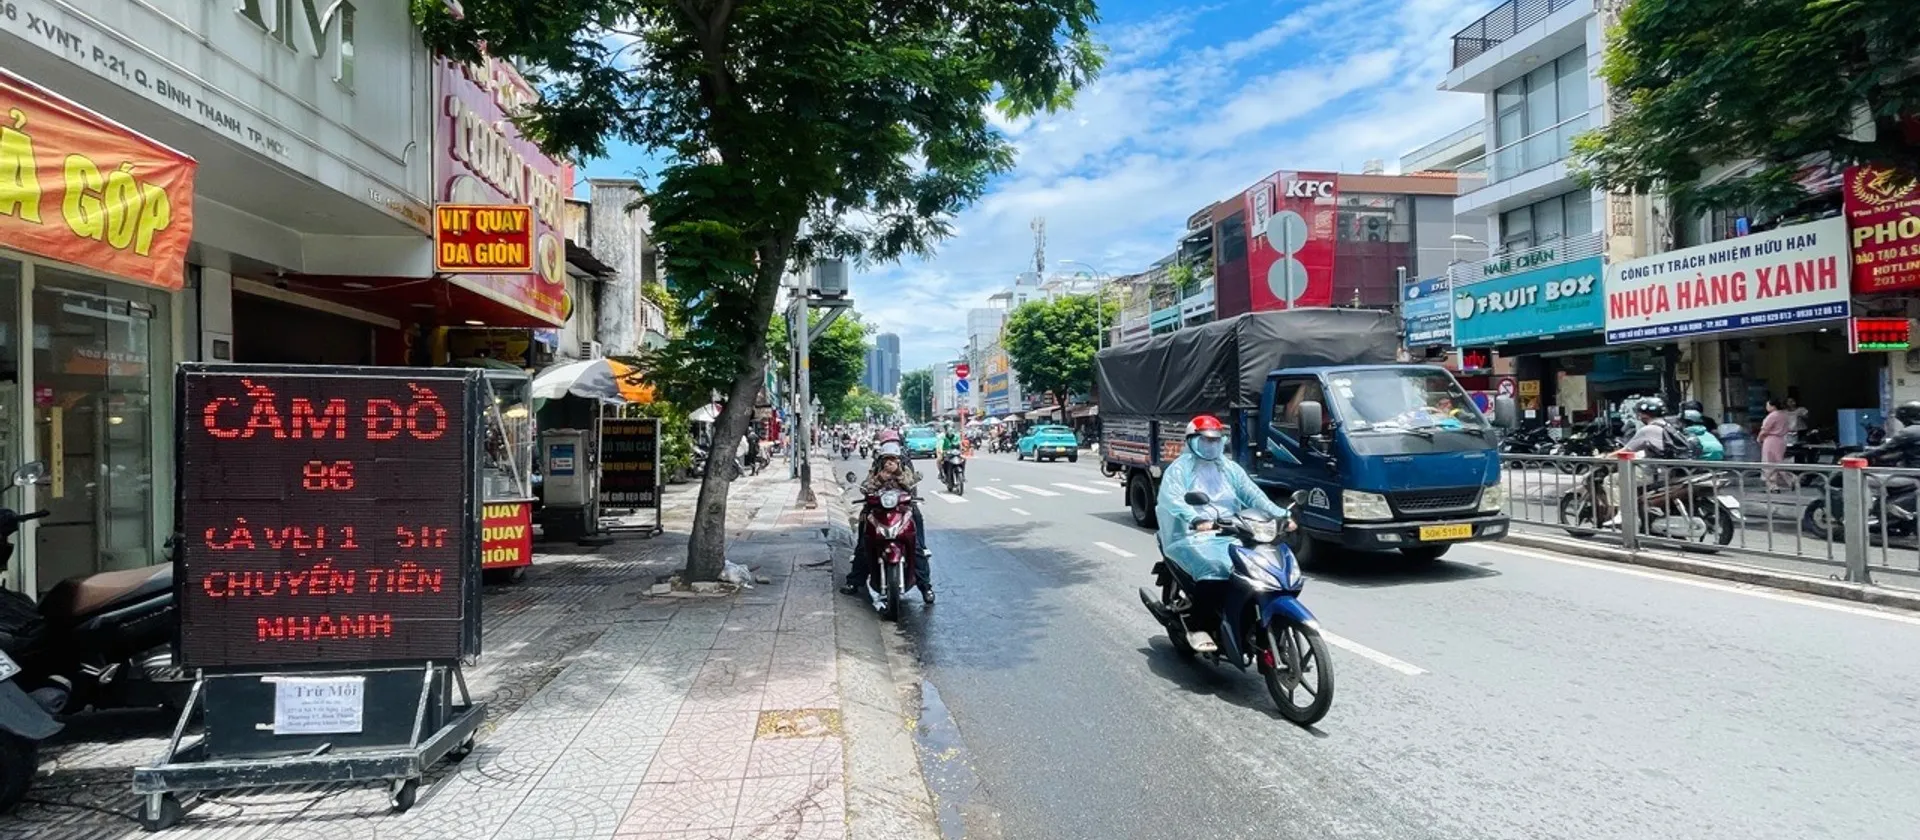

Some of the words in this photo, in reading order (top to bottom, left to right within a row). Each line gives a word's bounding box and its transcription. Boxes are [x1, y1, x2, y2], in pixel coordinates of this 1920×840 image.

[27, 12, 86, 58] XVNT,
[92, 44, 131, 80] P.21,
[135, 68, 153, 89] Q.
[156, 79, 192, 110] BÌNH
[195, 99, 242, 133] THẠNH
[61, 153, 172, 257] GÓP
[1285, 180, 1335, 198] KFC
[440, 209, 470, 236] VỊT
[475, 209, 525, 235] QUAY
[442, 242, 472, 265] DA
[475, 238, 524, 265] GIÒN
[1621, 265, 1650, 281] CÔNG
[1653, 262, 1665, 277] TY
[1667, 253, 1706, 274] TRÁCH
[1709, 244, 1751, 265] NHIỆM
[1755, 238, 1783, 256] HỮU
[1787, 232, 1817, 253] HẠN
[1477, 284, 1538, 315] FRUIT
[1545, 274, 1596, 302] BOX
[1610, 281, 1670, 321] NHỰA
[1676, 271, 1747, 311] HÀNG
[1756, 256, 1838, 300] XANH
[203, 379, 346, 440] CẦM
[361, 382, 448, 440] ĐỒ
[303, 460, 356, 490] 86
[257, 613, 393, 642] NHANH
